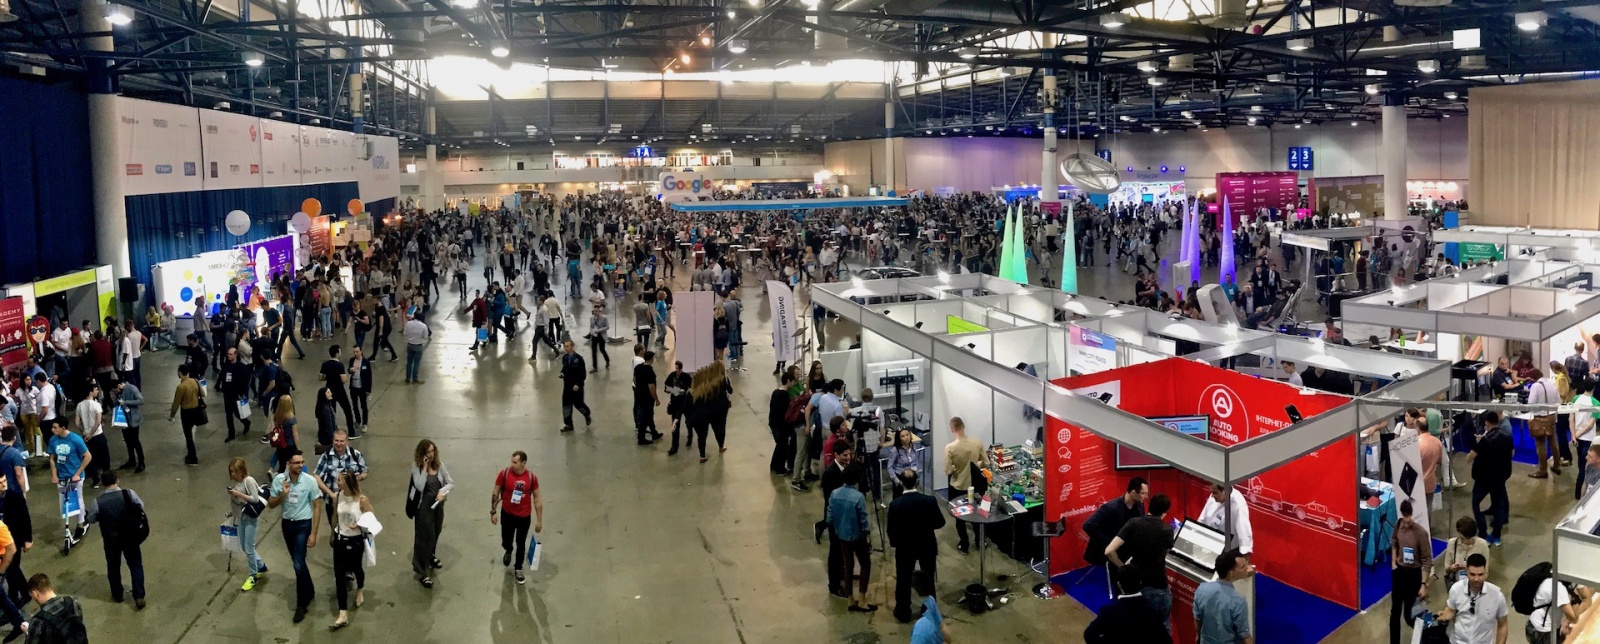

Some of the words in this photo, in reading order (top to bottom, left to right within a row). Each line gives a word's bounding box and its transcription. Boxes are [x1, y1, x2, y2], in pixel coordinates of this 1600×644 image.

[1291, 150, 1297, 160] 2
[1302, 150, 1309, 160] 3
[663, 174, 711, 193] Google
[1213, 419, 1232, 431] AUTO
